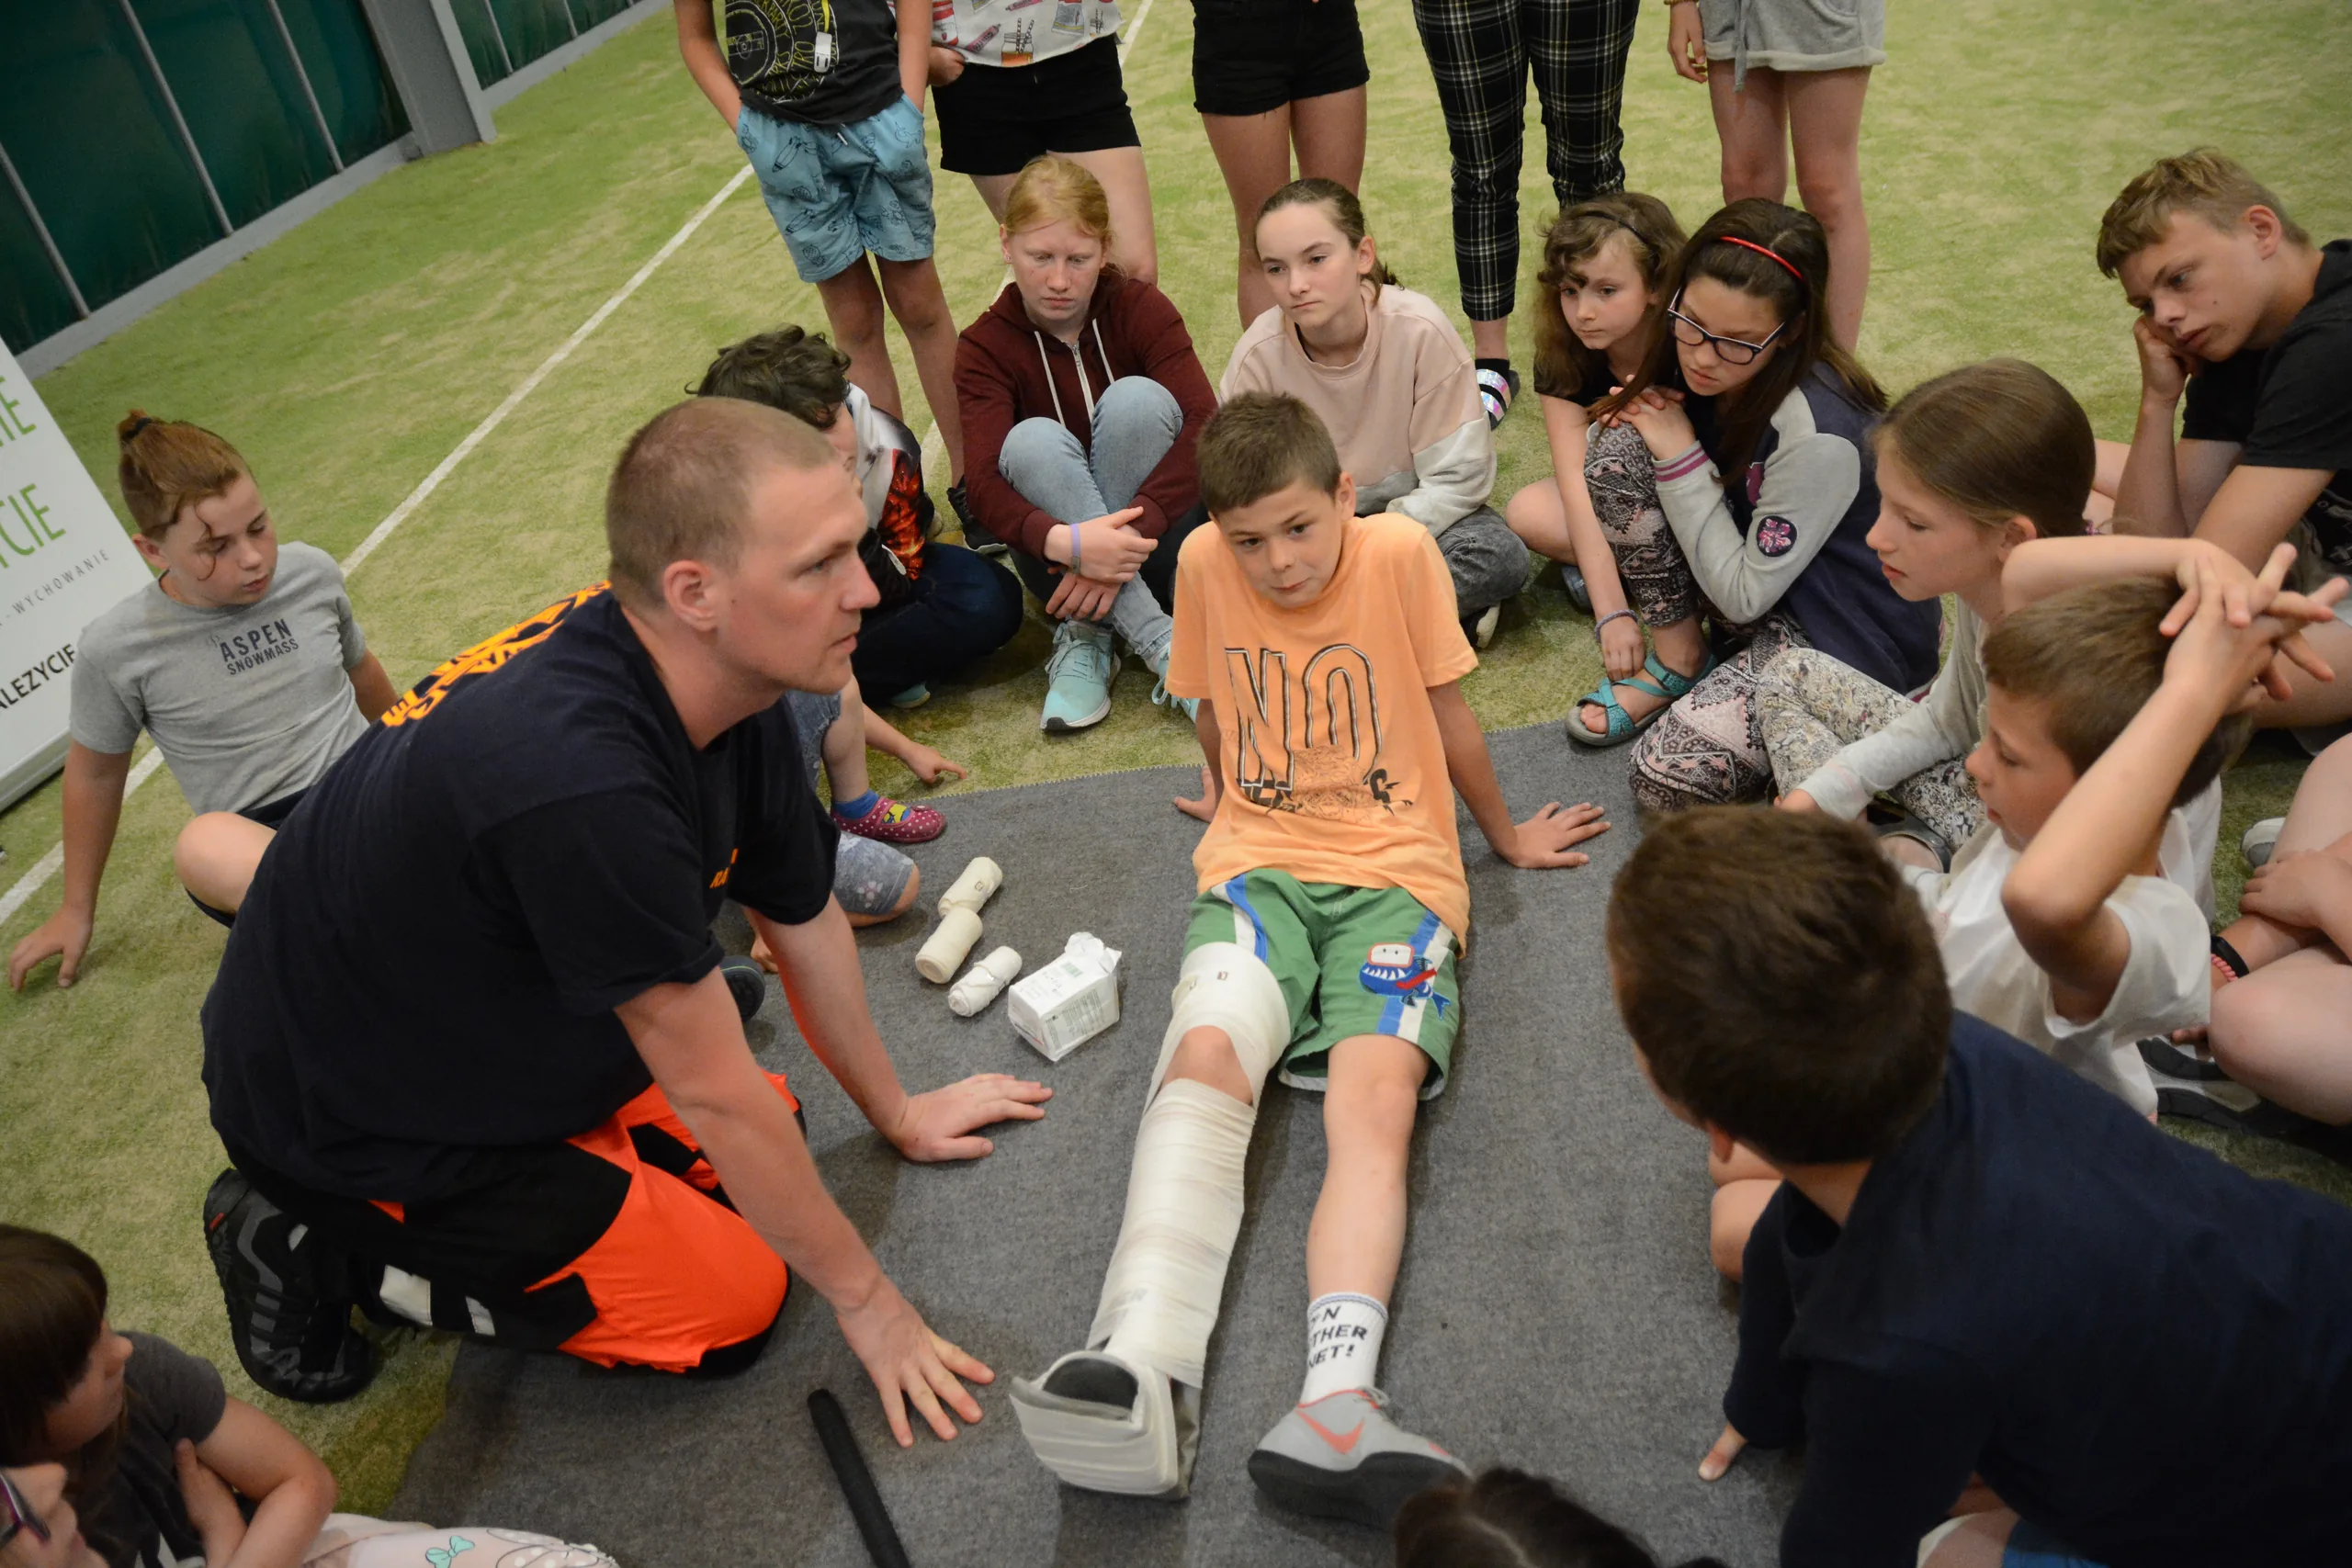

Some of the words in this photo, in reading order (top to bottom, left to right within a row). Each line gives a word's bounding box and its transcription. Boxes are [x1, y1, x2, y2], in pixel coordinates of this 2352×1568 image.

[0, 483, 66, 569] CIE
[220, 618, 292, 662] ASPEN
[227, 638, 300, 675] SNOWMASS
[1311, 1324, 1369, 1348] THER
